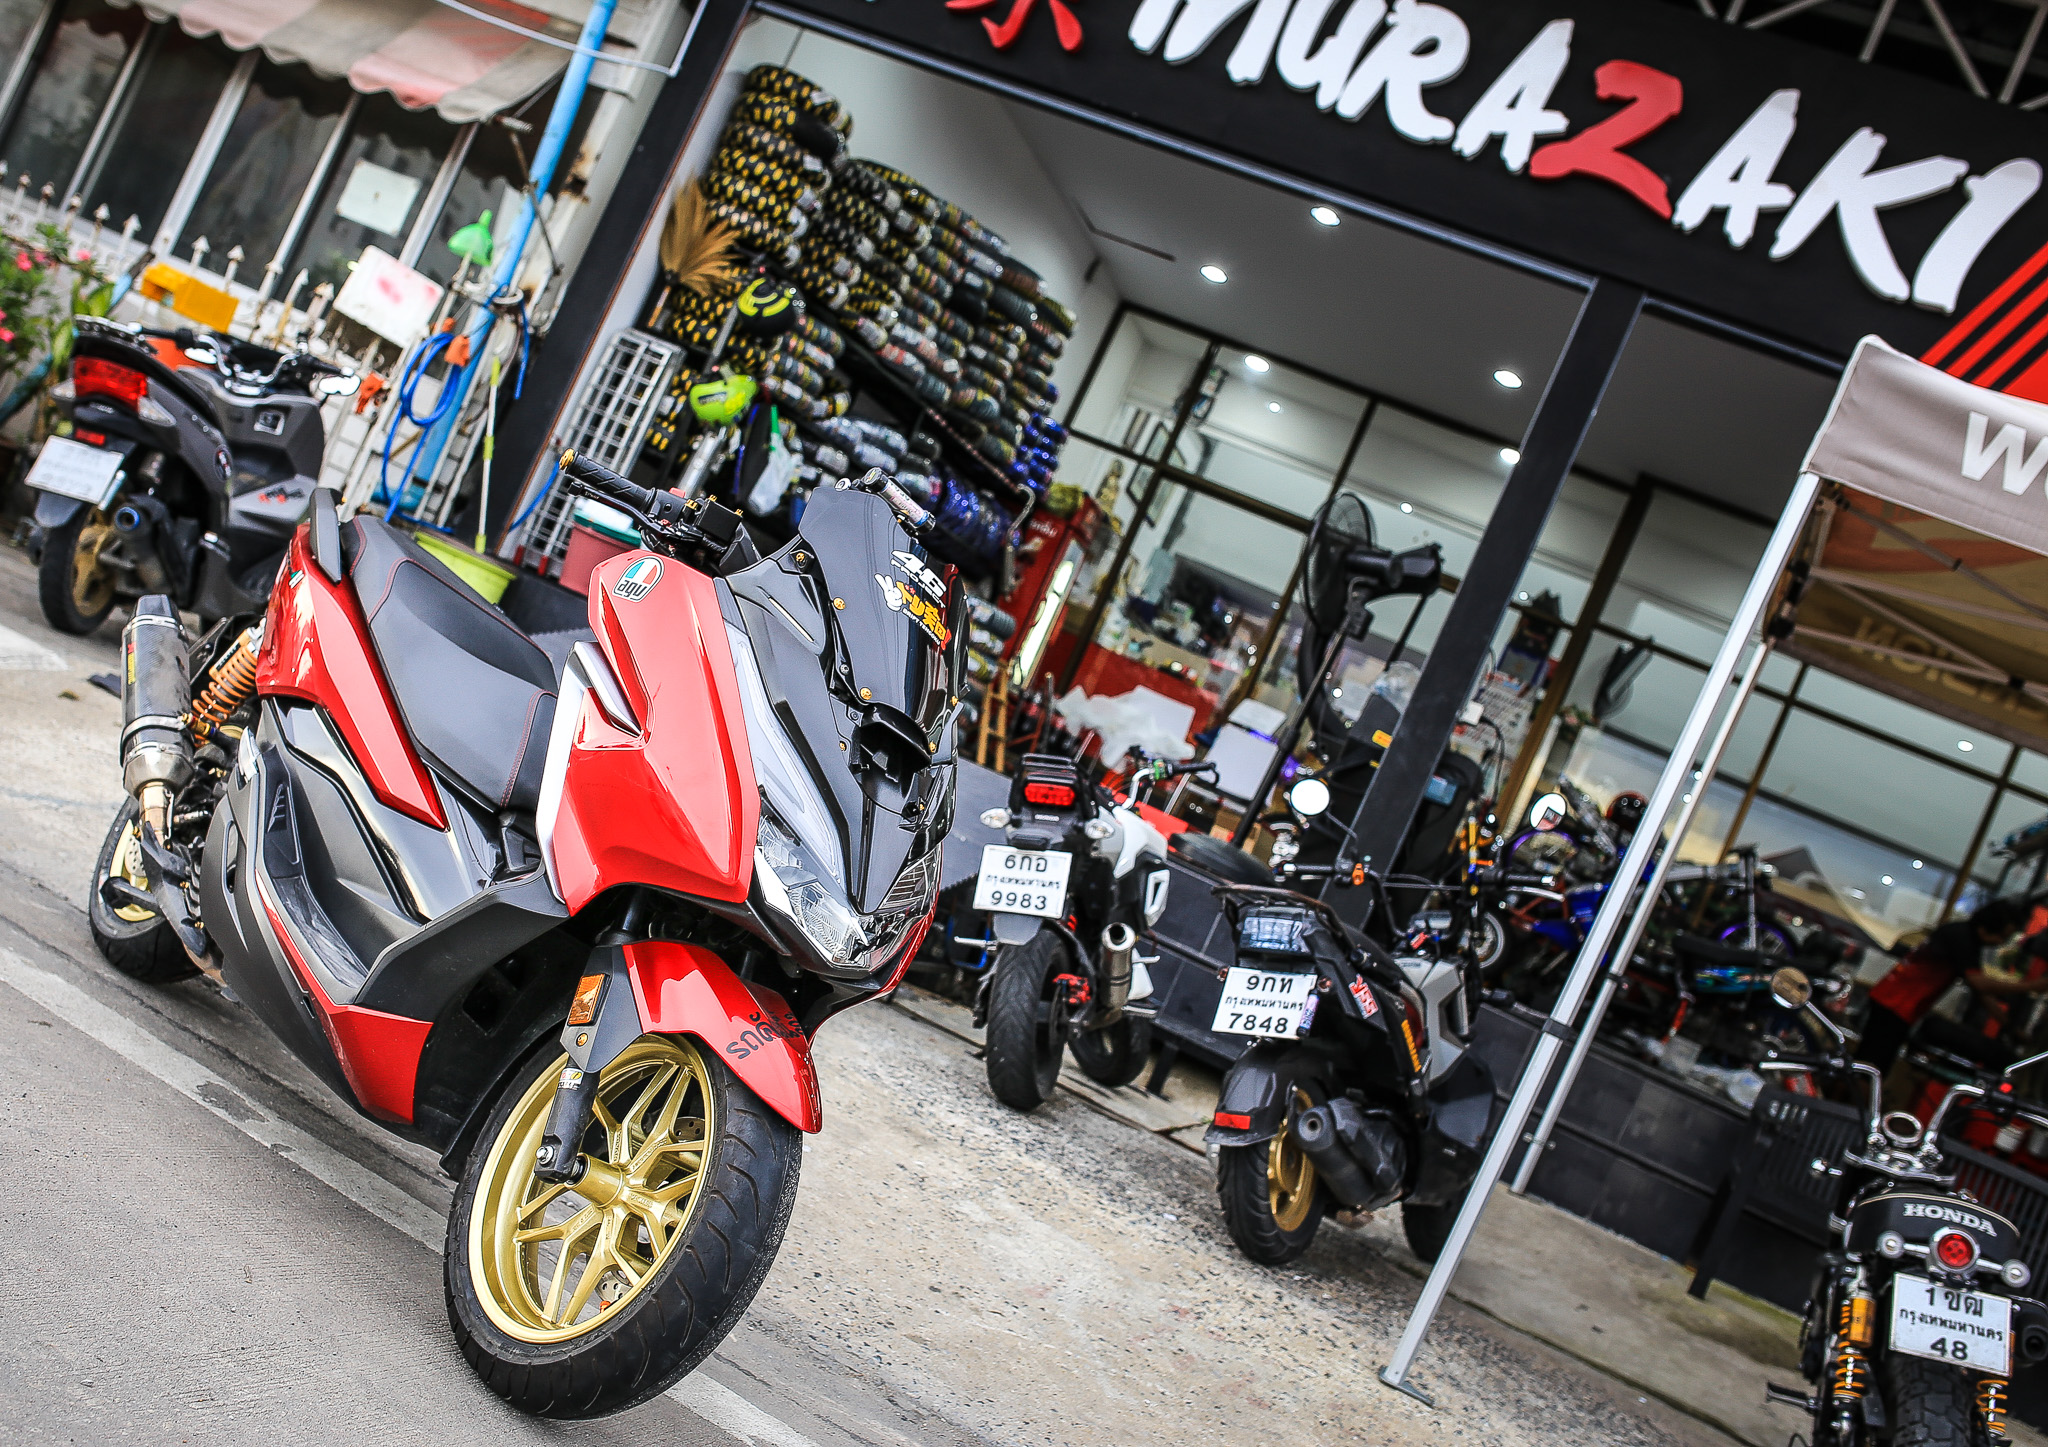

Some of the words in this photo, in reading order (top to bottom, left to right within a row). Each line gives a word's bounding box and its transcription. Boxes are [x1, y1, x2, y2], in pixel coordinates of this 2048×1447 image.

[1961, 409, 2048, 505] W
[991, 890, 1047, 910] 9983
[1246, 975, 1293, 994] 9กท
[1228, 1012, 1289, 1034] 7848
[1903, 1203, 1998, 1237] HONDA
[1899, 1307, 2004, 1342] กรุงเทพมหานคร
[1930, 1336, 1968, 1361] 48
